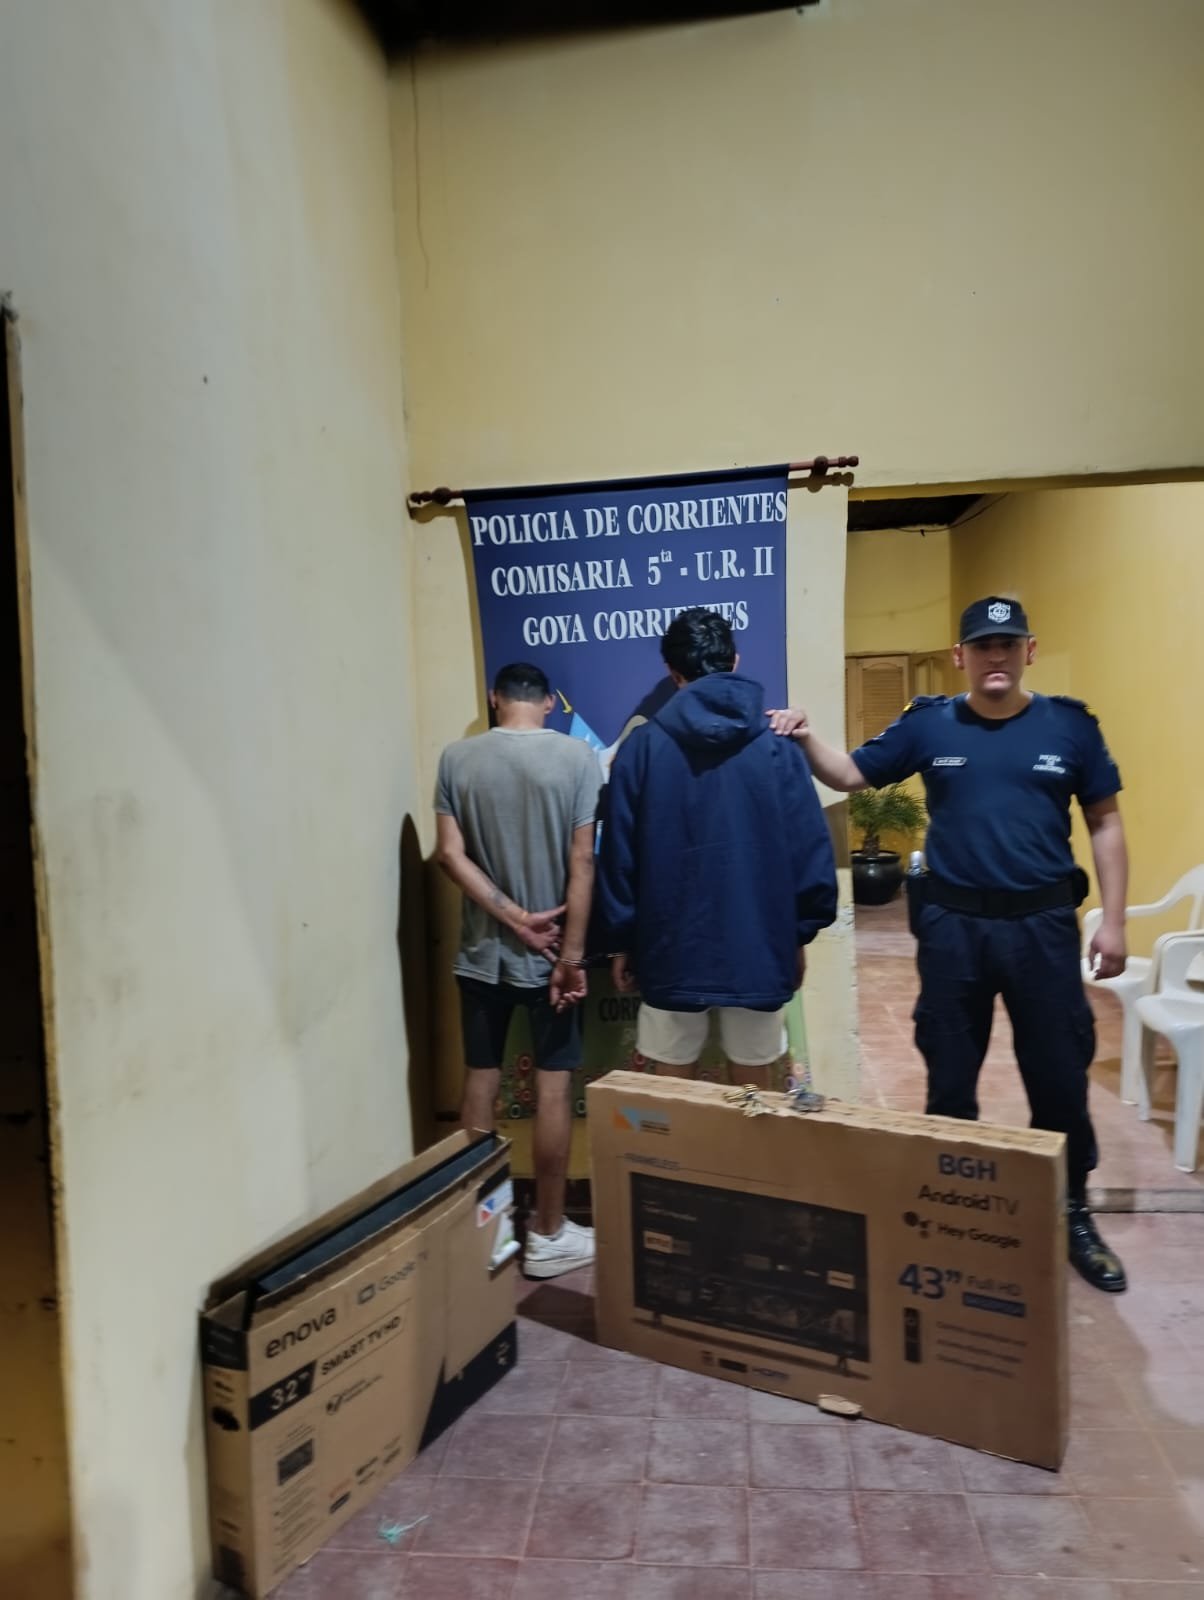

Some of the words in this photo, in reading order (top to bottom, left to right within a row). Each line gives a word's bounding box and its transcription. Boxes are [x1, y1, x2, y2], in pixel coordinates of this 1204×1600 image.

[470, 509, 578, 546] POLICIA
[583, 508, 619, 537] DE
[626, 490, 788, 535] CORRIENTES
[490, 557, 634, 597] COMISARIA
[695, 548, 745, 582] U.R.
[753, 546, 775, 577] II
[522, 613, 588, 647] GOYA
[593, 600, 749, 642] CORRIES
[938, 1153, 997, 1182] BGH
[967, 1227, 1022, 1250] Google
[264, 1306, 338, 1360] enova
[319, 1338, 367, 1377] SMART
